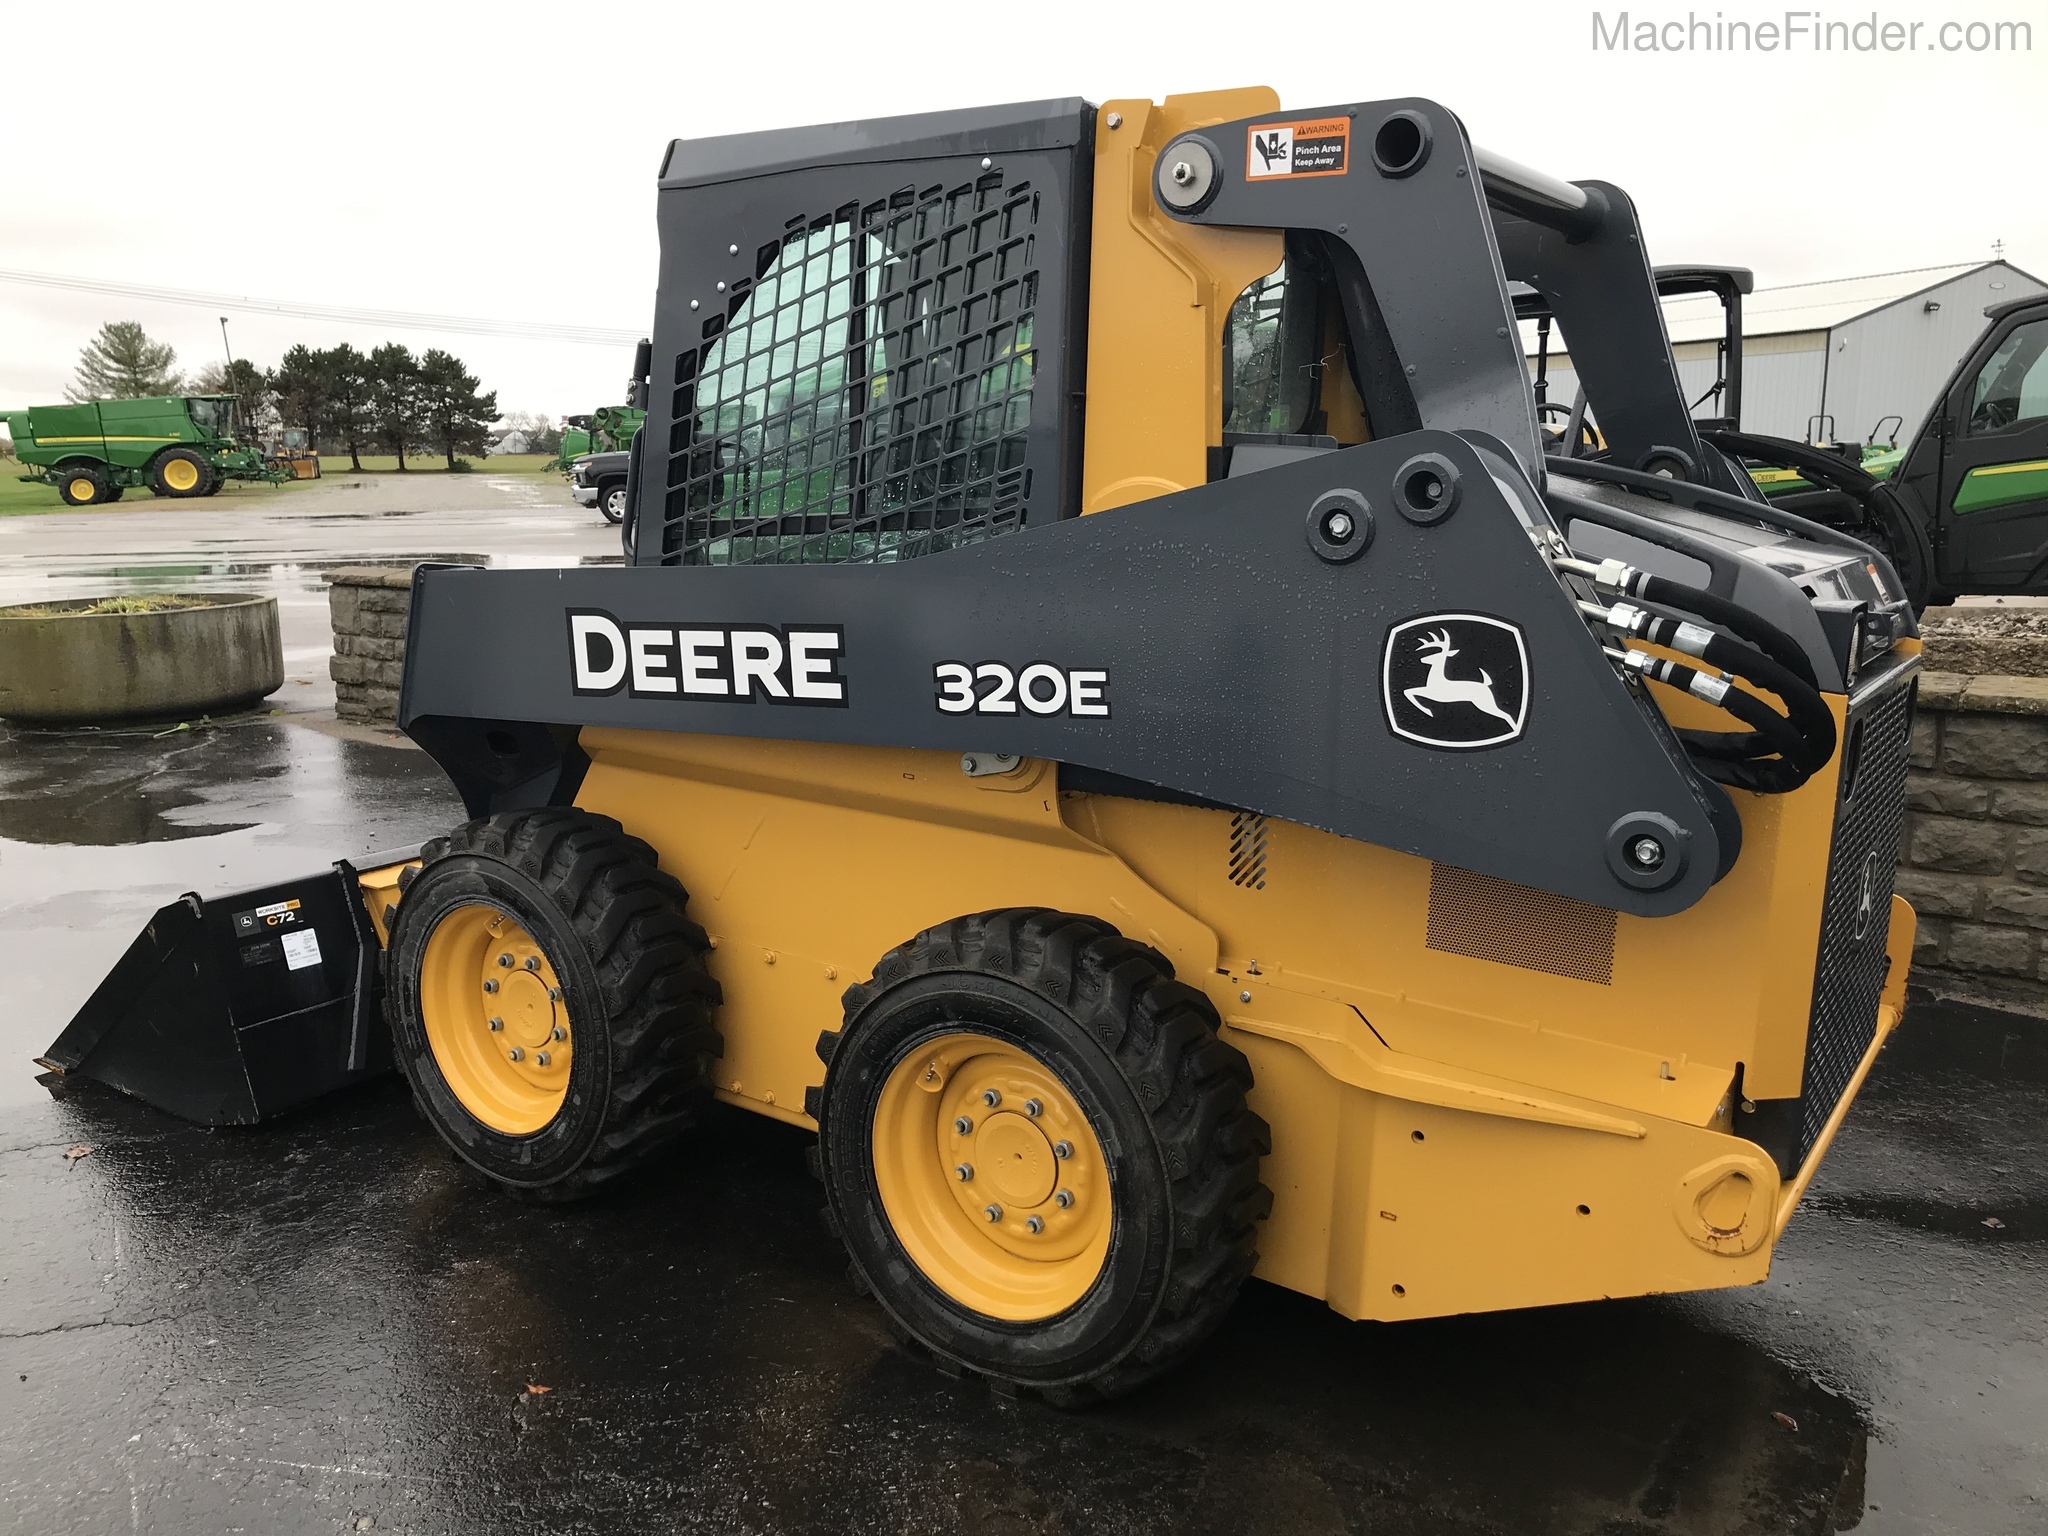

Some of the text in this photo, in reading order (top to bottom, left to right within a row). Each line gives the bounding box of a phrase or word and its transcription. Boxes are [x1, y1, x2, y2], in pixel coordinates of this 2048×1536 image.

[1306, 124, 1344, 134] WARNING
[1295, 144, 1341, 156] Pinch Area
[1295, 157, 1335, 167] Keep Away
[1758, 473, 1776, 482] DEERE
[570, 613, 844, 702] DEERE
[934, 662, 1109, 717] 320E
[257, 904, 286, 915] WORKSITE
[266, 911, 295, 926] C72
